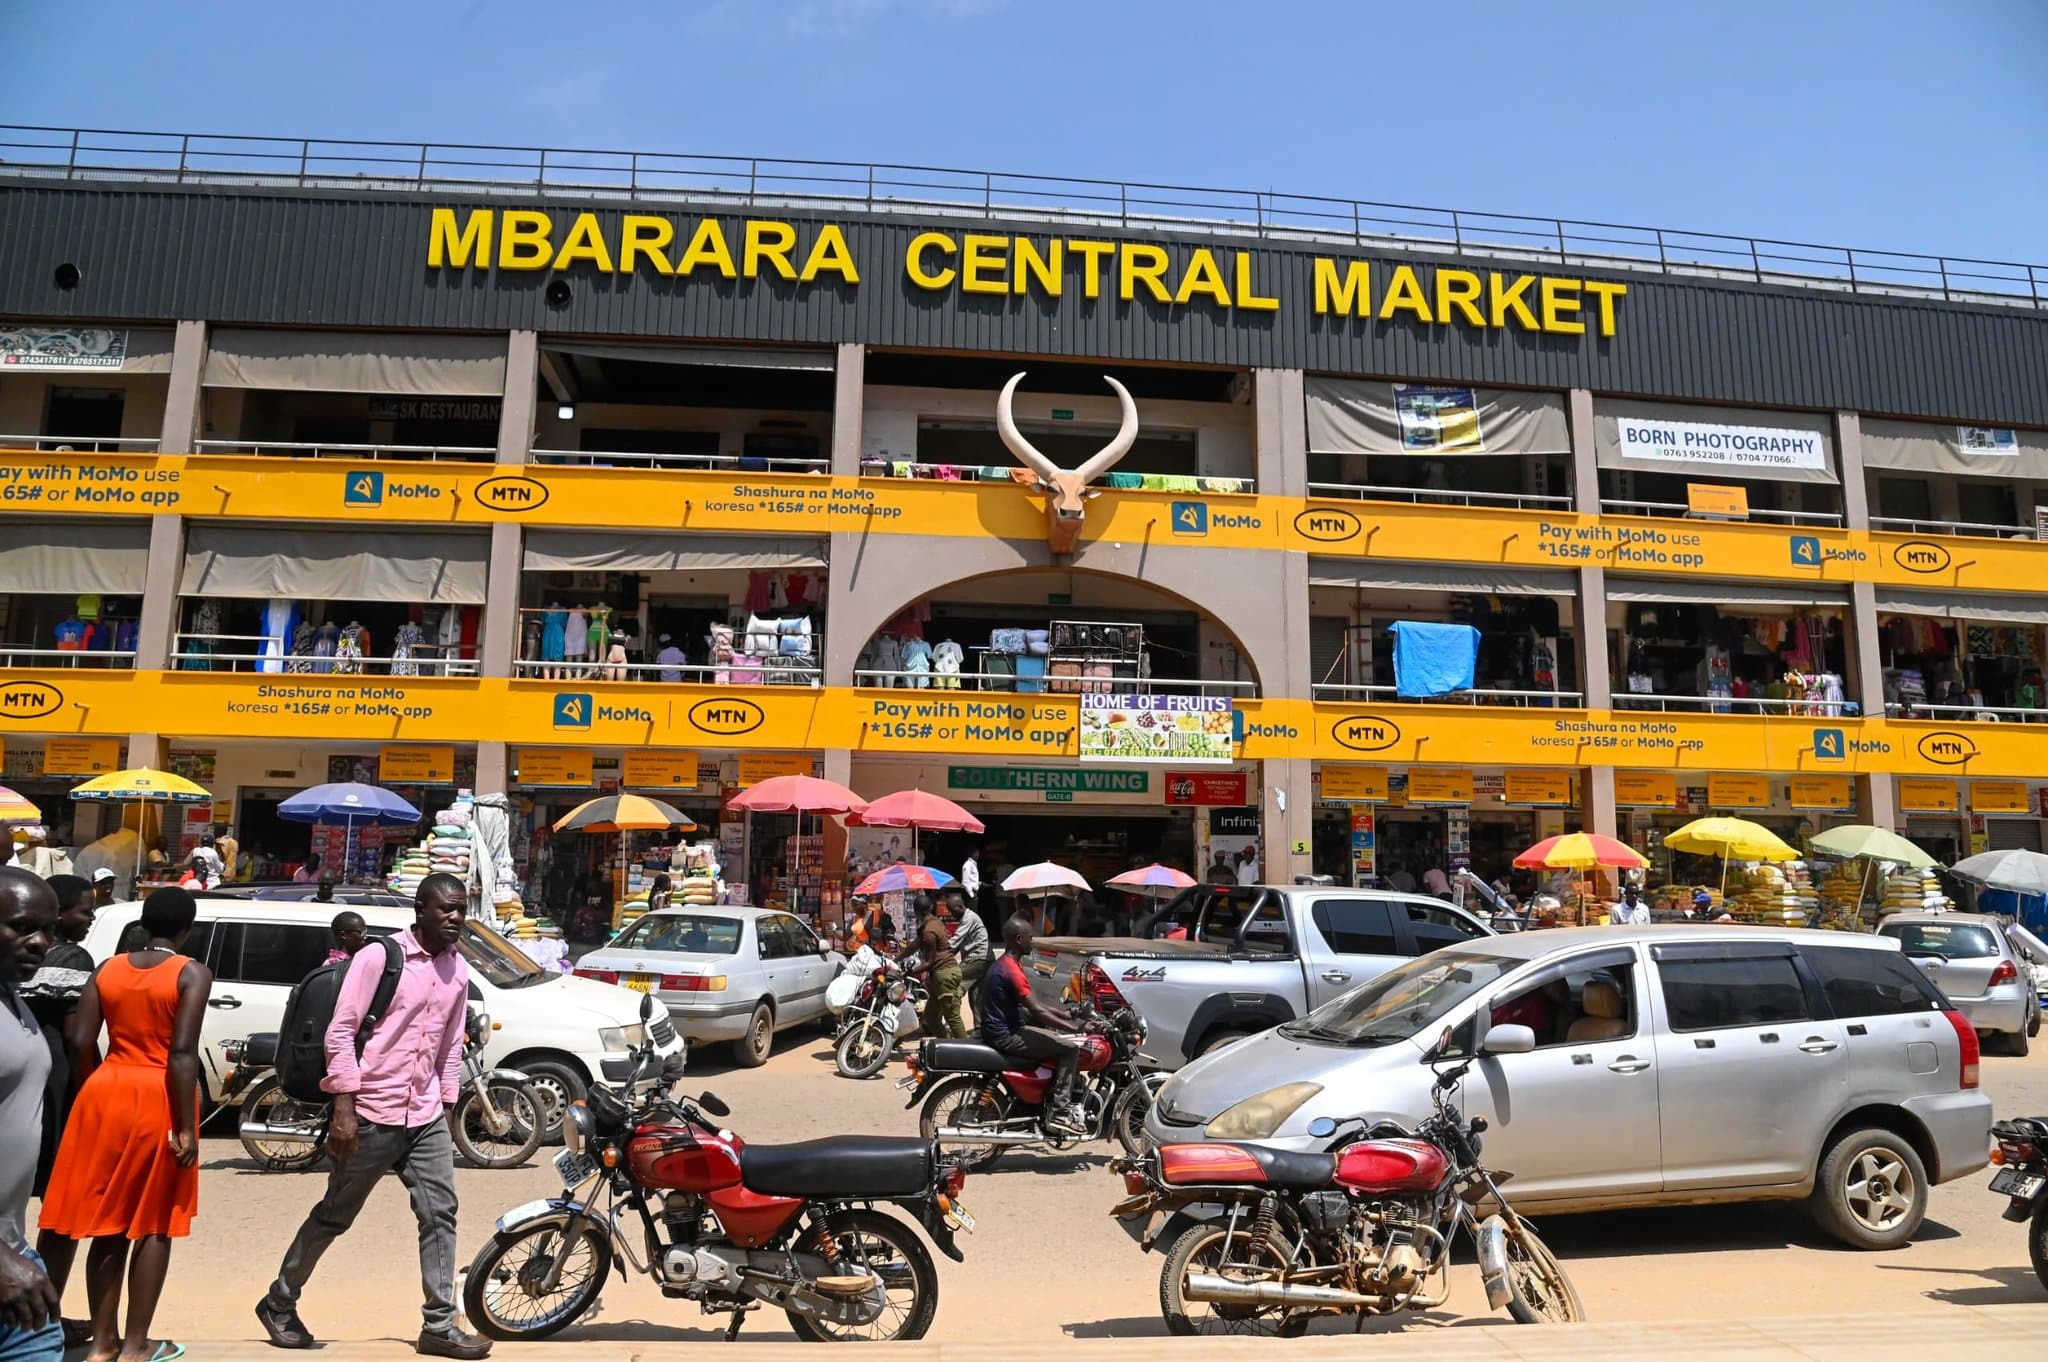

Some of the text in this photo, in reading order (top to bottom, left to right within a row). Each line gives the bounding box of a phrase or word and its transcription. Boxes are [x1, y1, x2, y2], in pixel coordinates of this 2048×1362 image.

[427, 208, 1628, 337] MBARARA CENTRAL MARKET
[1627, 428, 1814, 454] BORN PHOTOGRAPHY
[1663, 449, 1690, 458] 0763
[28, 464, 72, 480] with
[78, 466, 138, 481] MoMo
[144, 470, 180, 482] use
[0, 485, 180, 506] 65# or MoMo app
[388, 483, 440, 498] MoMo
[492, 487, 531, 501] MTN
[734, 485, 875, 500] Shashura na MoMo
[705, 500, 755, 512] koresa
[808, 504, 823, 514] or
[827, 502, 870, 515] MoMo
[872, 506, 902, 519] app
[1213, 514, 1262, 528] MoMo
[1310, 518, 1346, 532] MTN
[1540, 523, 1700, 546] Pay with MoMo use
[1595, 549, 1613, 559] or
[1618, 547, 1667, 563] MoMo
[1672, 552, 1704, 568] app
[1825, 548, 1867, 561] MoMo
[1907, 551, 1938, 564] MTN
[4, 692, 45, 707] MTN
[258, 685, 405, 700] Shashura na MoMo
[227, 701, 278, 714] koresa
[334, 705, 350, 715] or
[354, 703, 398, 716] MoMo
[403, 706, 432, 719] app
[1082, 694, 1227, 711] HOME OF FRUITS
[598, 706, 651, 721] MoMo
[706, 709, 747, 724] MTN
[874, 701, 1067, 721] Pay with MoMo use
[1249, 723, 1298, 738] MoMo
[1348, 726, 1384, 740] MTN
[1555, 720, 1677, 734] Shashura na MoMo
[938, 727, 959, 739] or
[965, 725, 1024, 741] MoMo
[1030, 729, 1068, 747] app
[1532, 735, 1575, 746] koresa
[1620, 738, 1634, 747] or
[1637, 736, 1674, 748] MoMo
[1849, 739, 1890, 753] MoMo
[1931, 742, 1962, 755] MTN
[955, 768, 1143, 789] SOUTHERN WING
[1297, 843, 1304, 852] 5
[1122, 965, 1167, 978] 4x4
